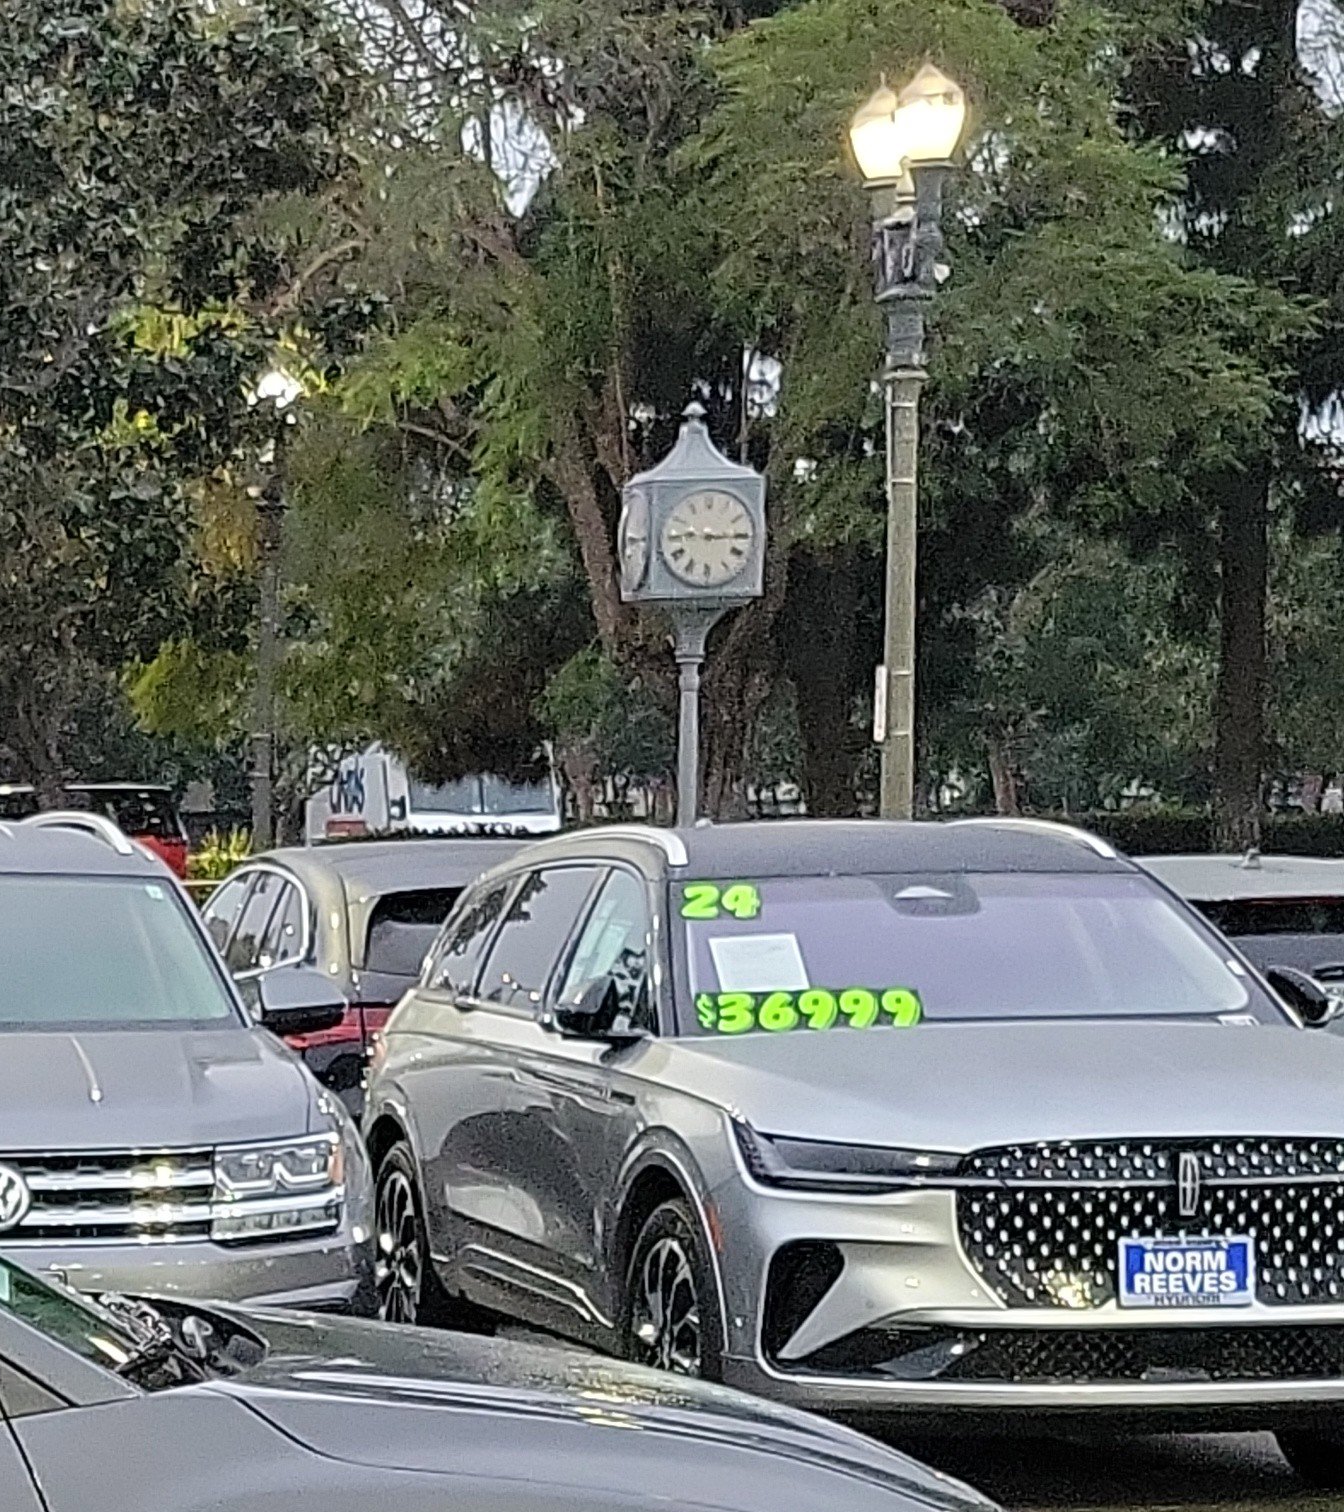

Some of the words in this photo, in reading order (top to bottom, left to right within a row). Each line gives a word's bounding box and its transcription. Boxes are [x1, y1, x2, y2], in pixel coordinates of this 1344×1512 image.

[681, 884, 761, 919] 24
[696, 988, 922, 1034] $36999
[1143, 1251, 1227, 1272] NORM
[1133, 1271, 1238, 1293] REEVES
